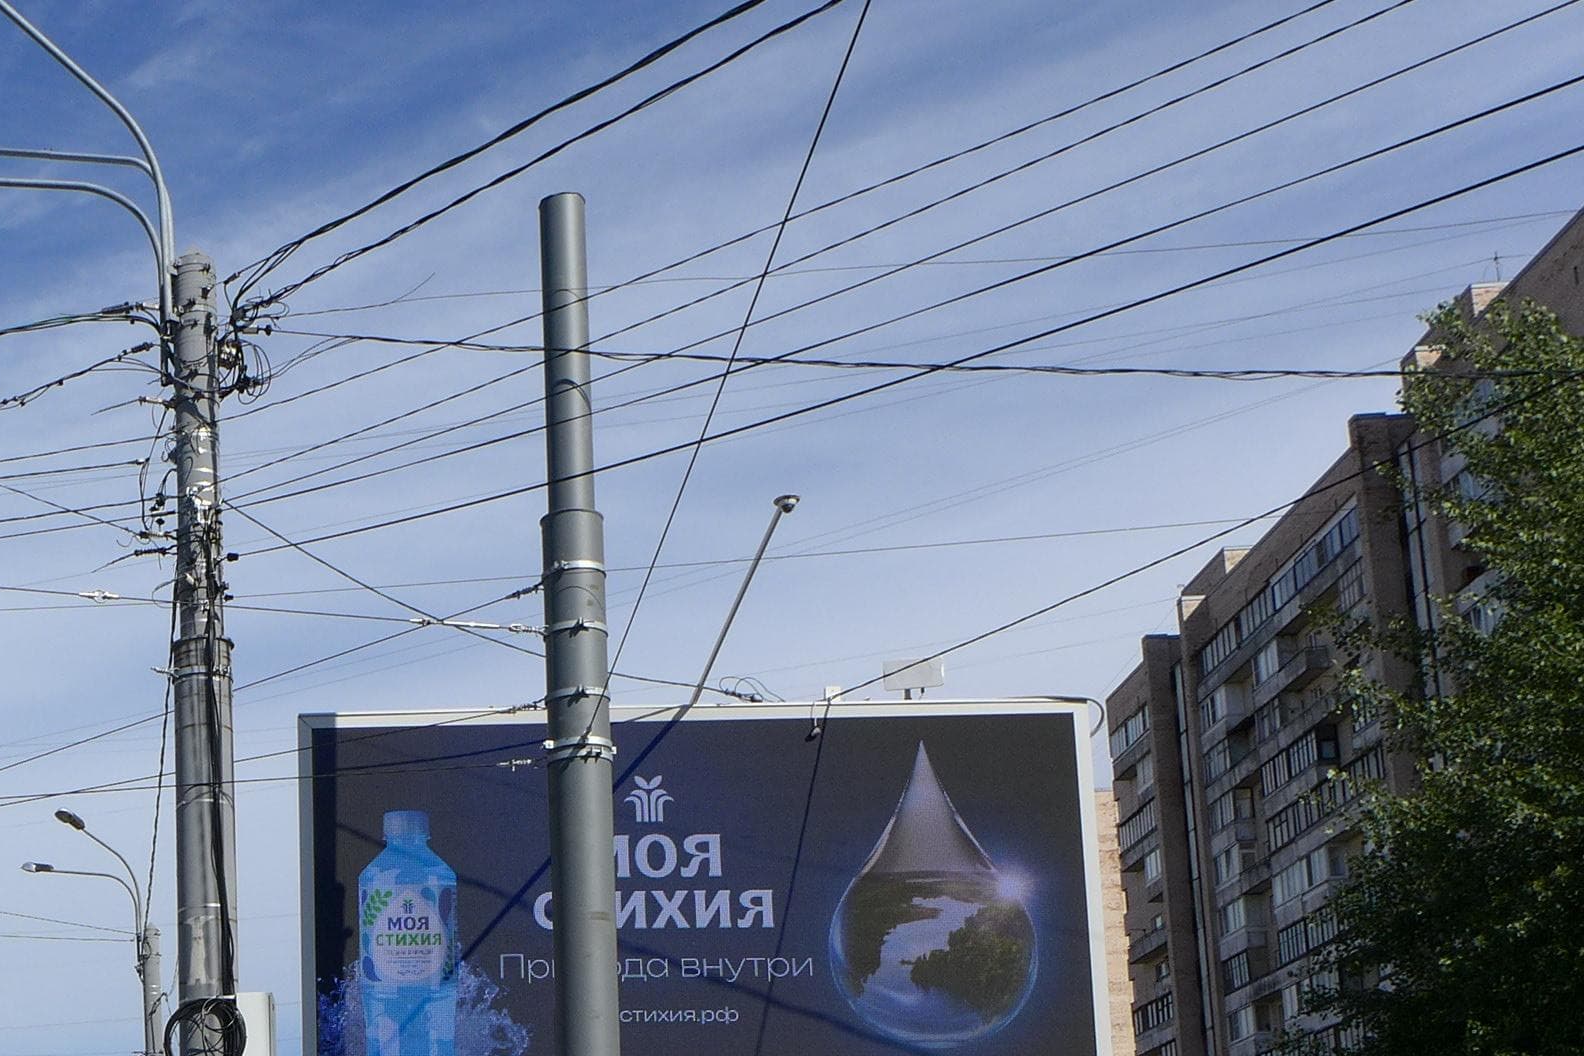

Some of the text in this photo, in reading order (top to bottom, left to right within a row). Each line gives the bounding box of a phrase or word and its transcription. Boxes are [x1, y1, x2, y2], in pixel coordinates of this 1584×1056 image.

[533, 889, 776, 929] СИХИЯ
[387, 916, 430, 931] МОЯ
[376, 933, 442, 947] СТИХИЯ
[680, 957, 814, 983] внутри
